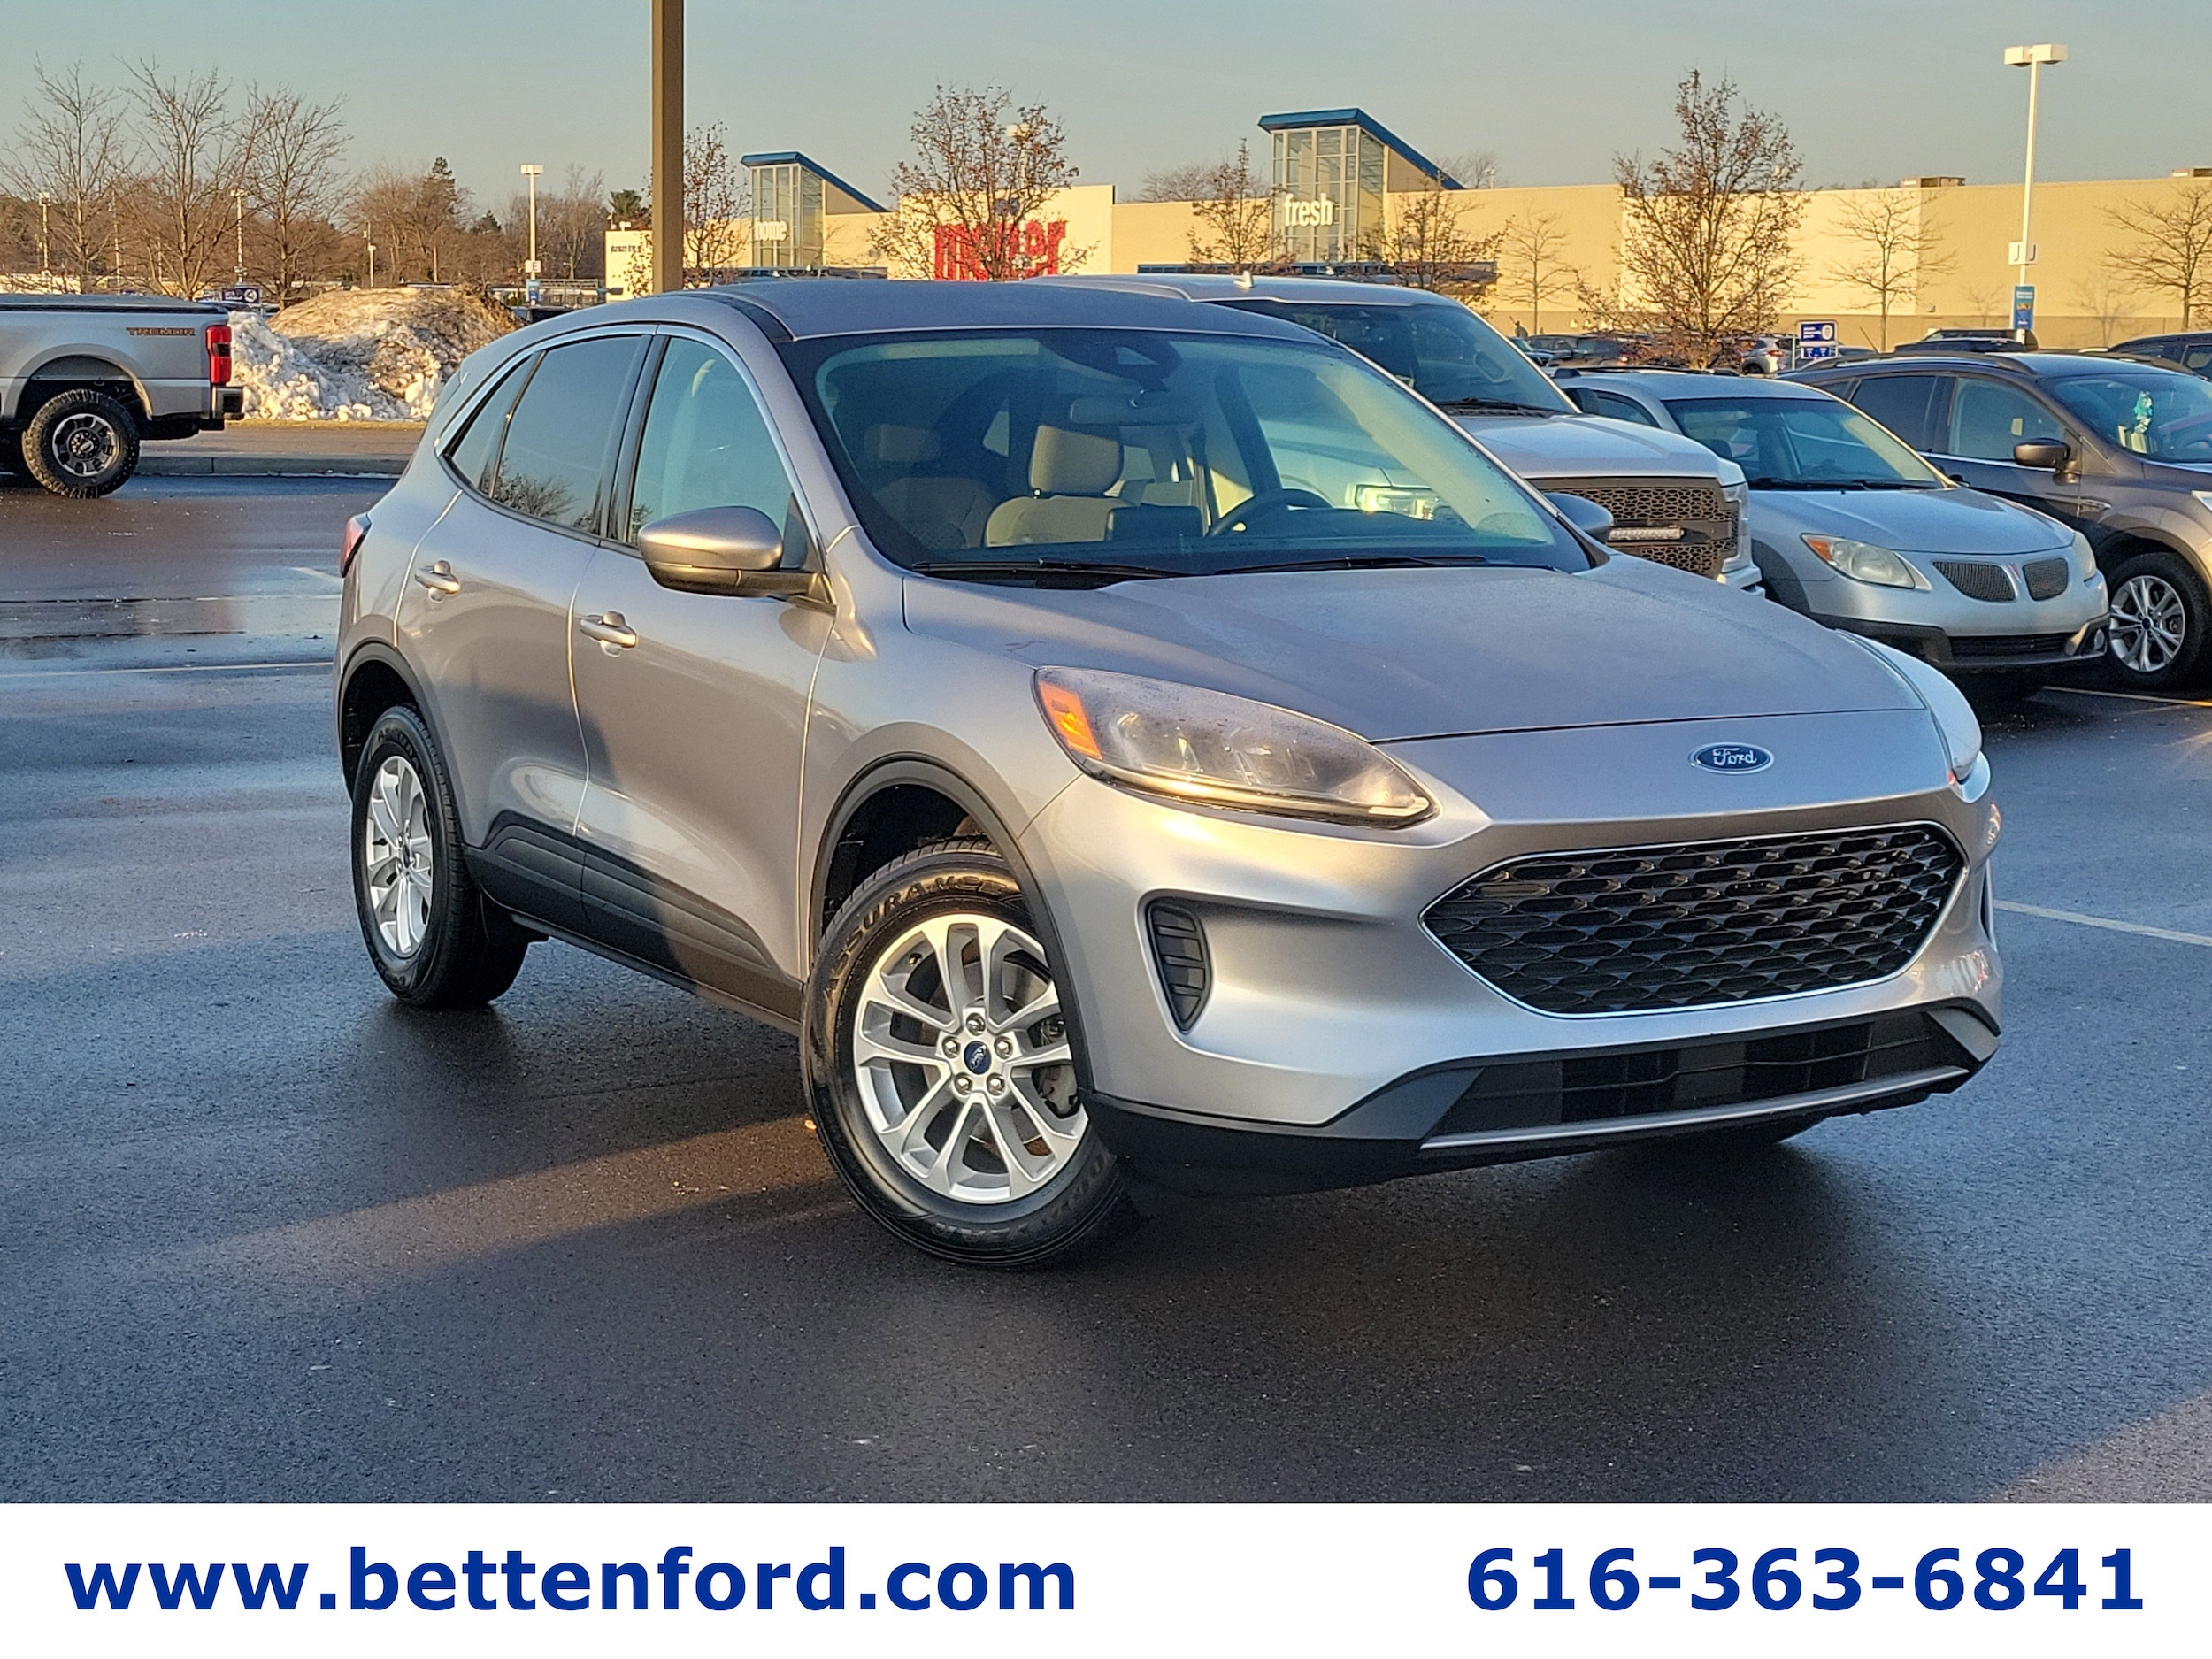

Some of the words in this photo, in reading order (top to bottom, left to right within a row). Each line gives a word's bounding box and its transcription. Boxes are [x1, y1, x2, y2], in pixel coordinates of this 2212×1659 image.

[1283, 192, 1334, 227] fresh
[754, 215, 787, 242] home
[1712, 748, 1758, 766] Ford
